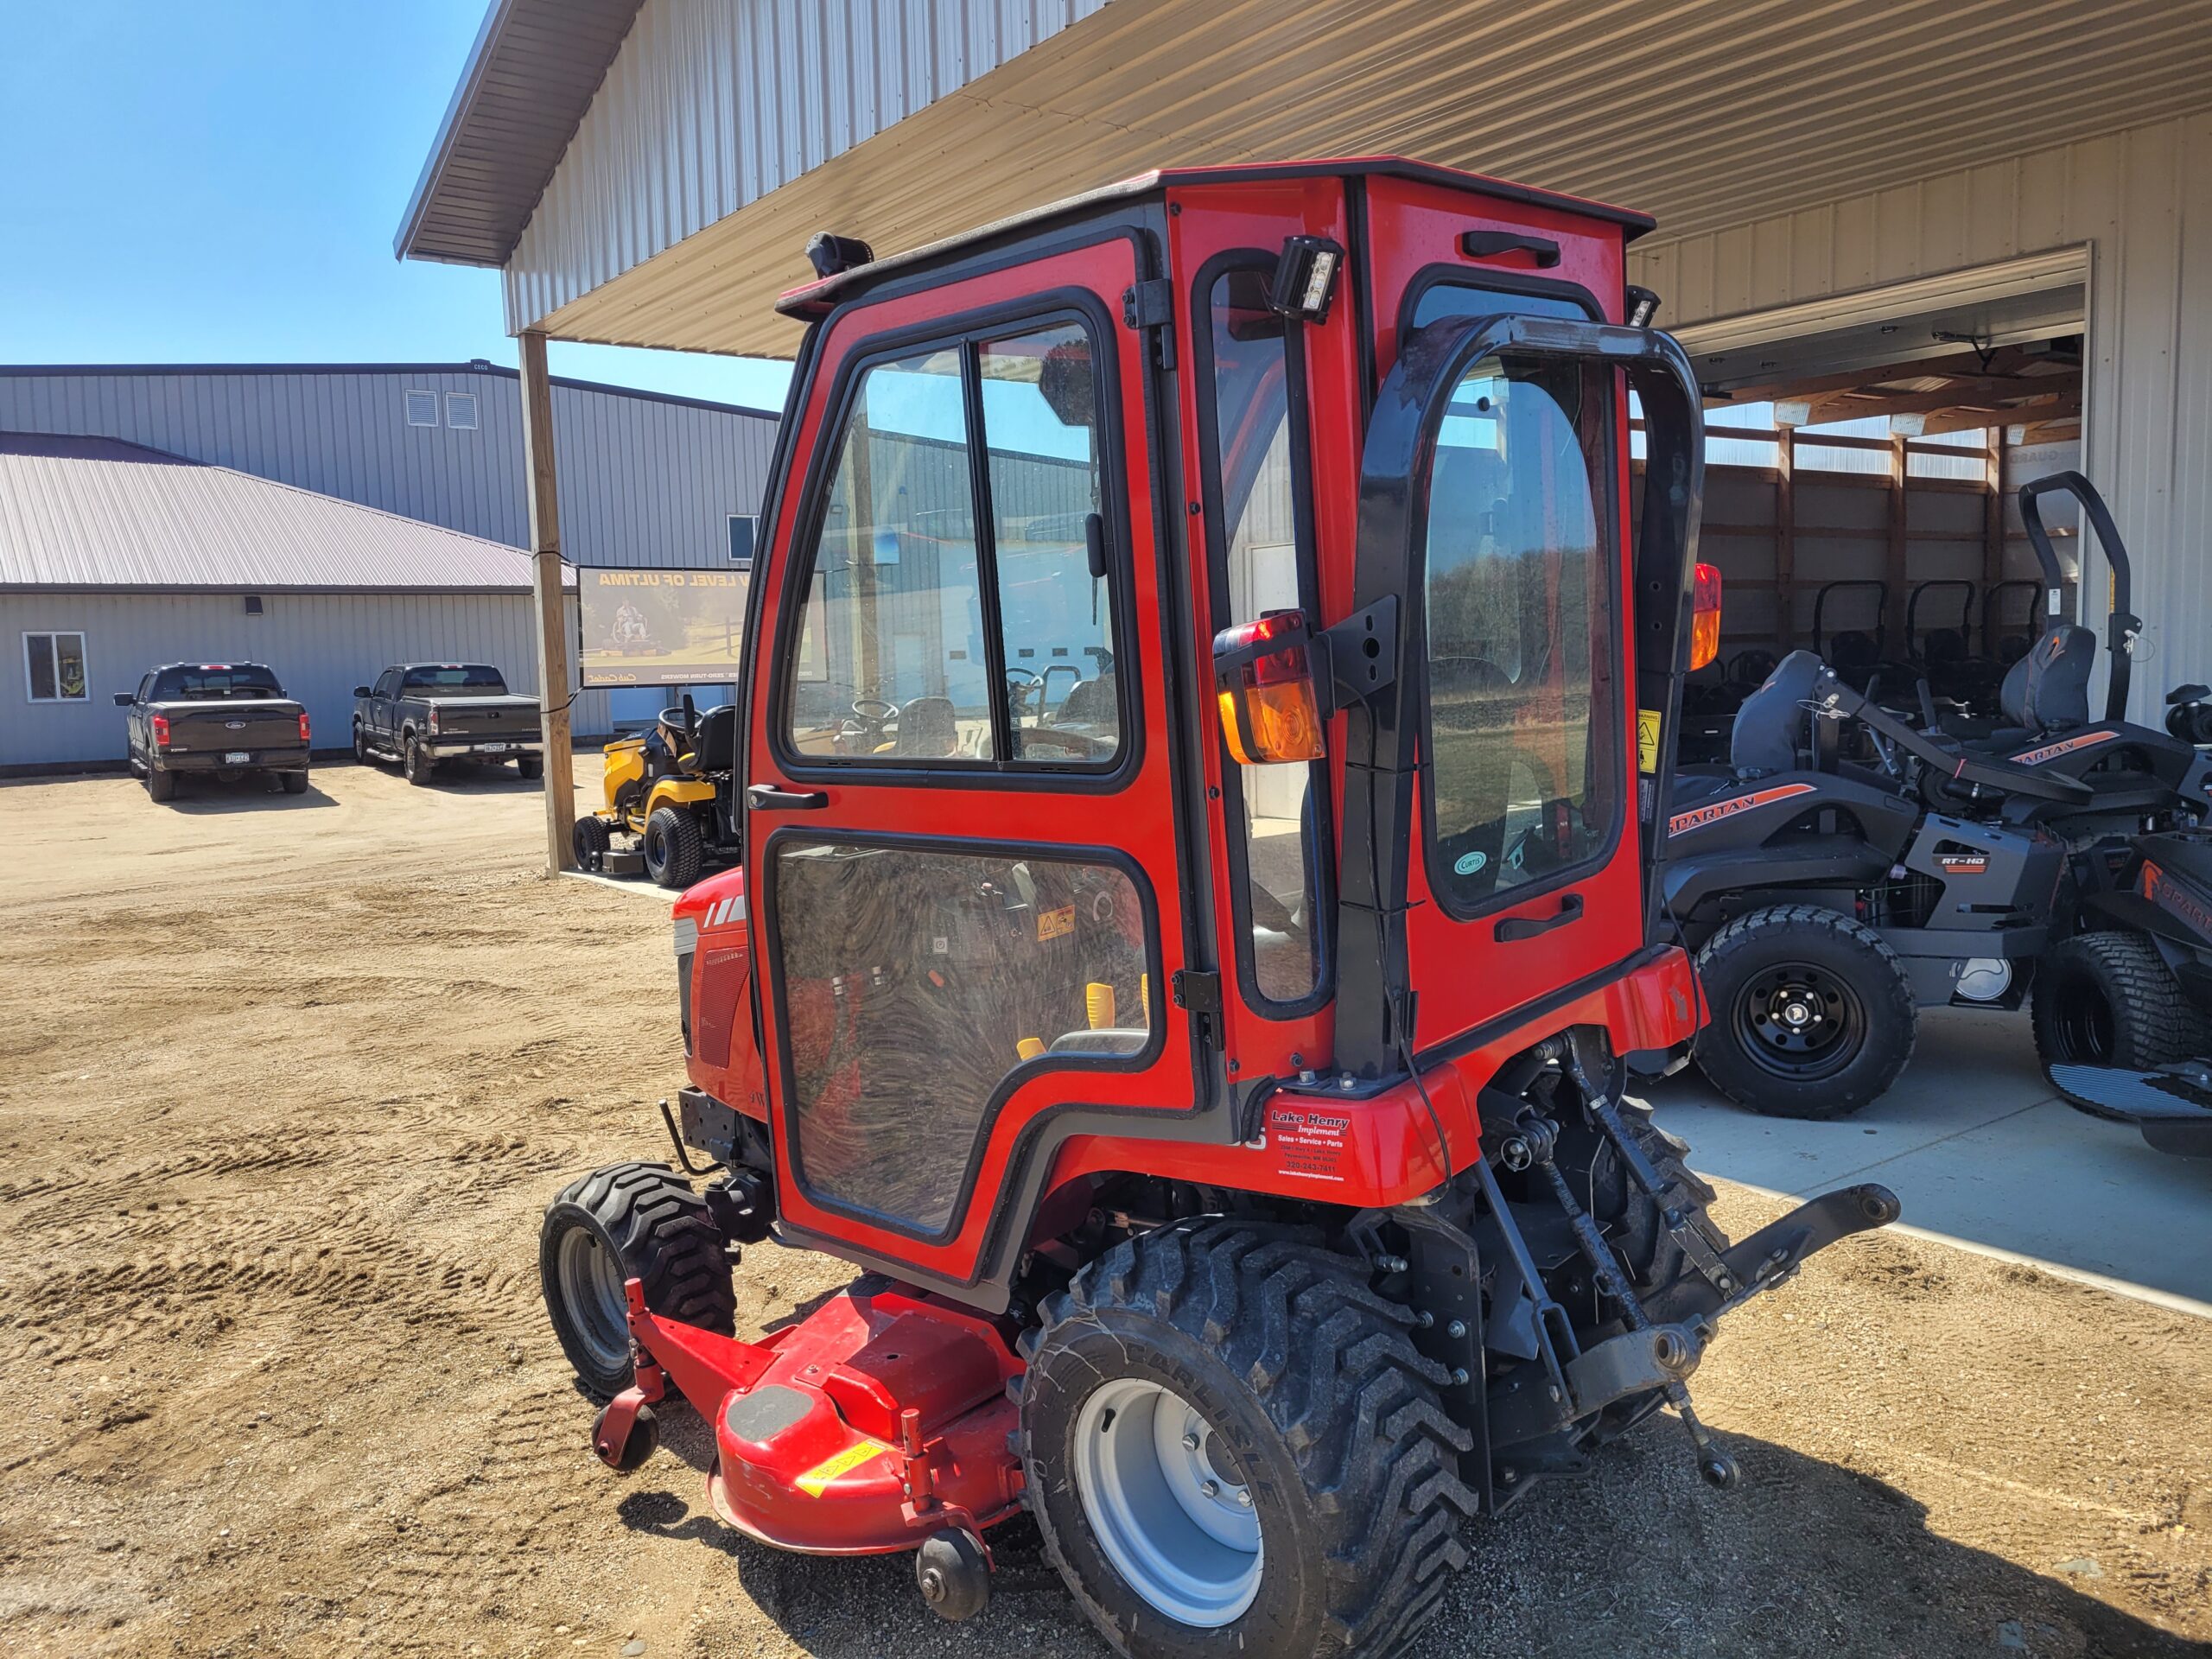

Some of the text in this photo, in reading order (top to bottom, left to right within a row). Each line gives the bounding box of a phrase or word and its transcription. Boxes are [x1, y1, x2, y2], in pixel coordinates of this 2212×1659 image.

[1461, 857, 1480, 869] CURTIS
[1272, 1110, 1350, 1129] Lake Henry
[1298, 1125, 1339, 1136] Implement
[1299, 1137, 1322, 1146] Service
[1326, 1139, 1344, 1147] Parts
[1125, 1343, 1281, 1508] CARLISLE
